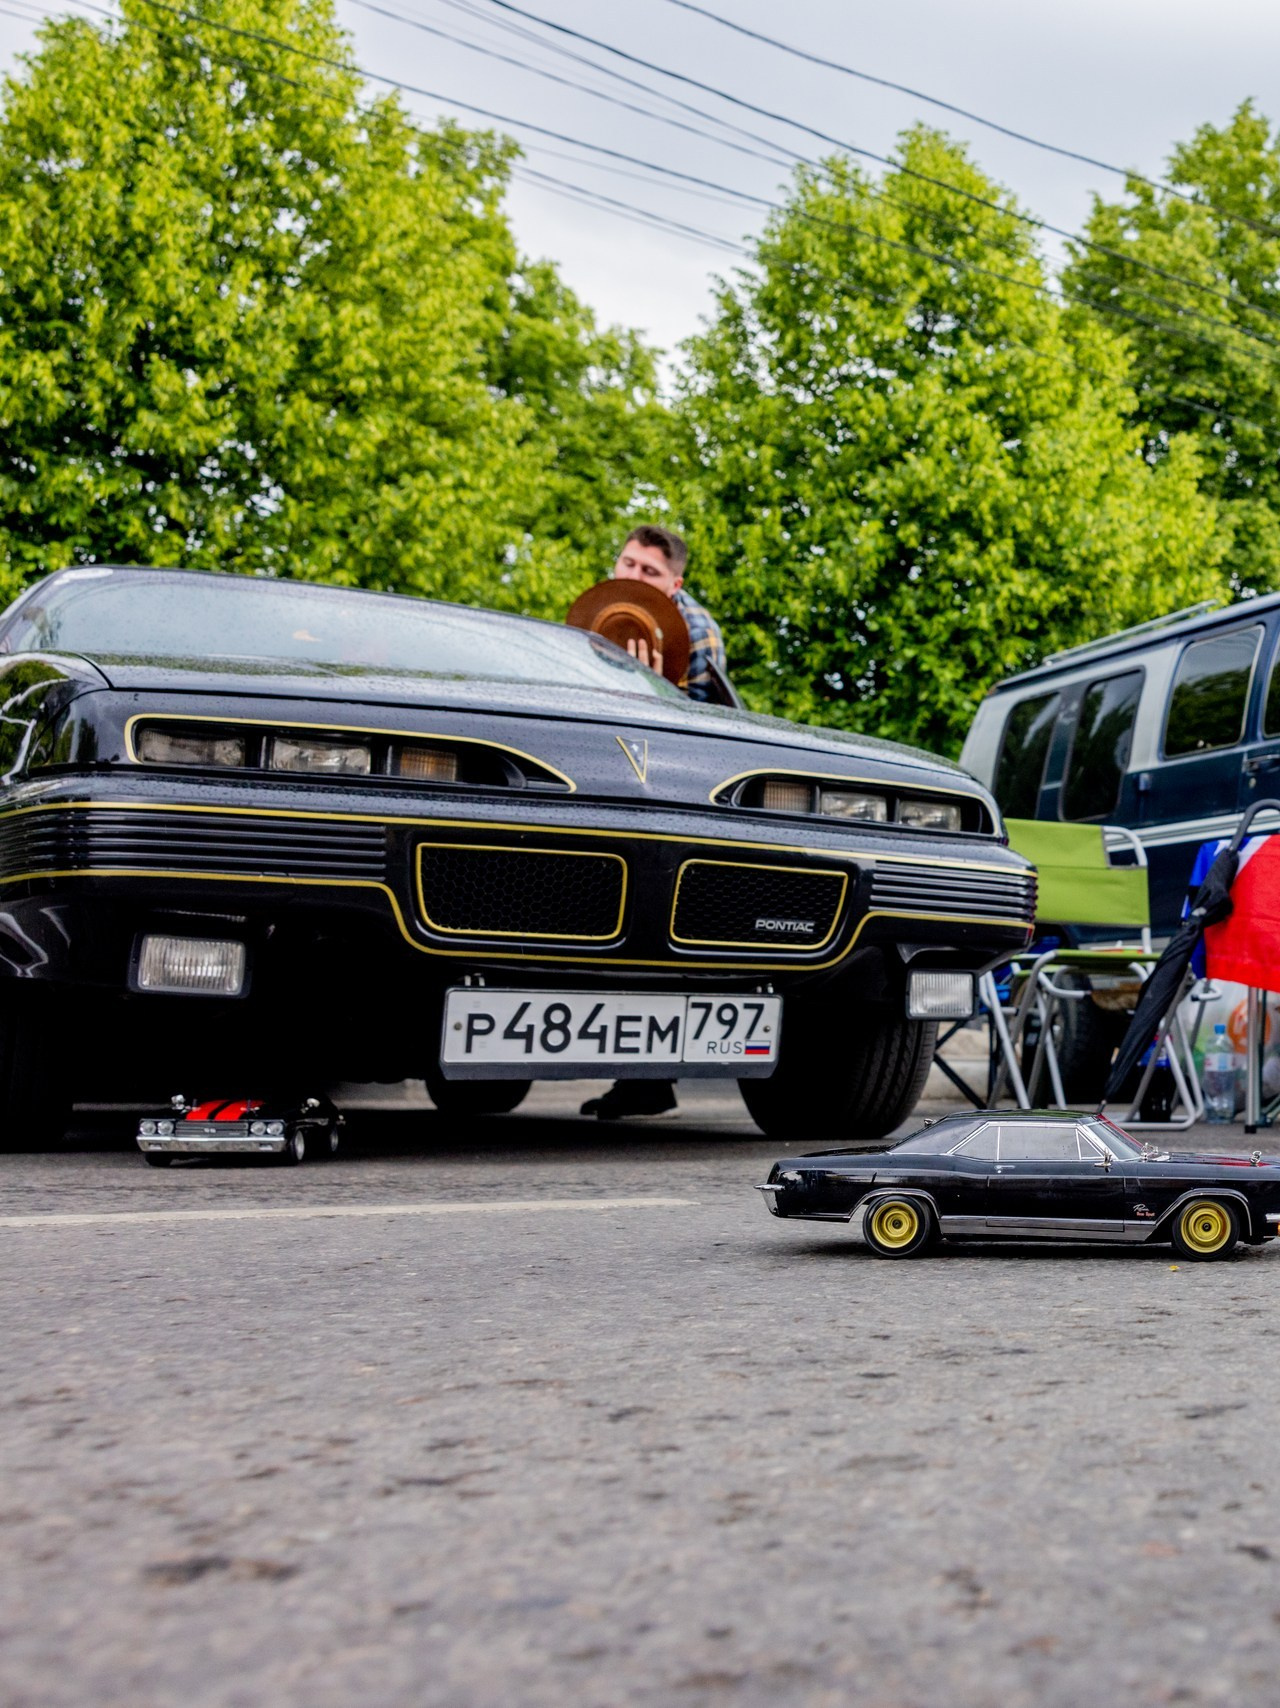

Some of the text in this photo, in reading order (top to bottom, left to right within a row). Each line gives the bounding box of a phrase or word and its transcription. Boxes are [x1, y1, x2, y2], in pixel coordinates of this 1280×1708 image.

[755, 918, 815, 933] PONTIAC
[689, 1001, 766, 1041] 797
[706, 1041, 743, 1055] RUS
